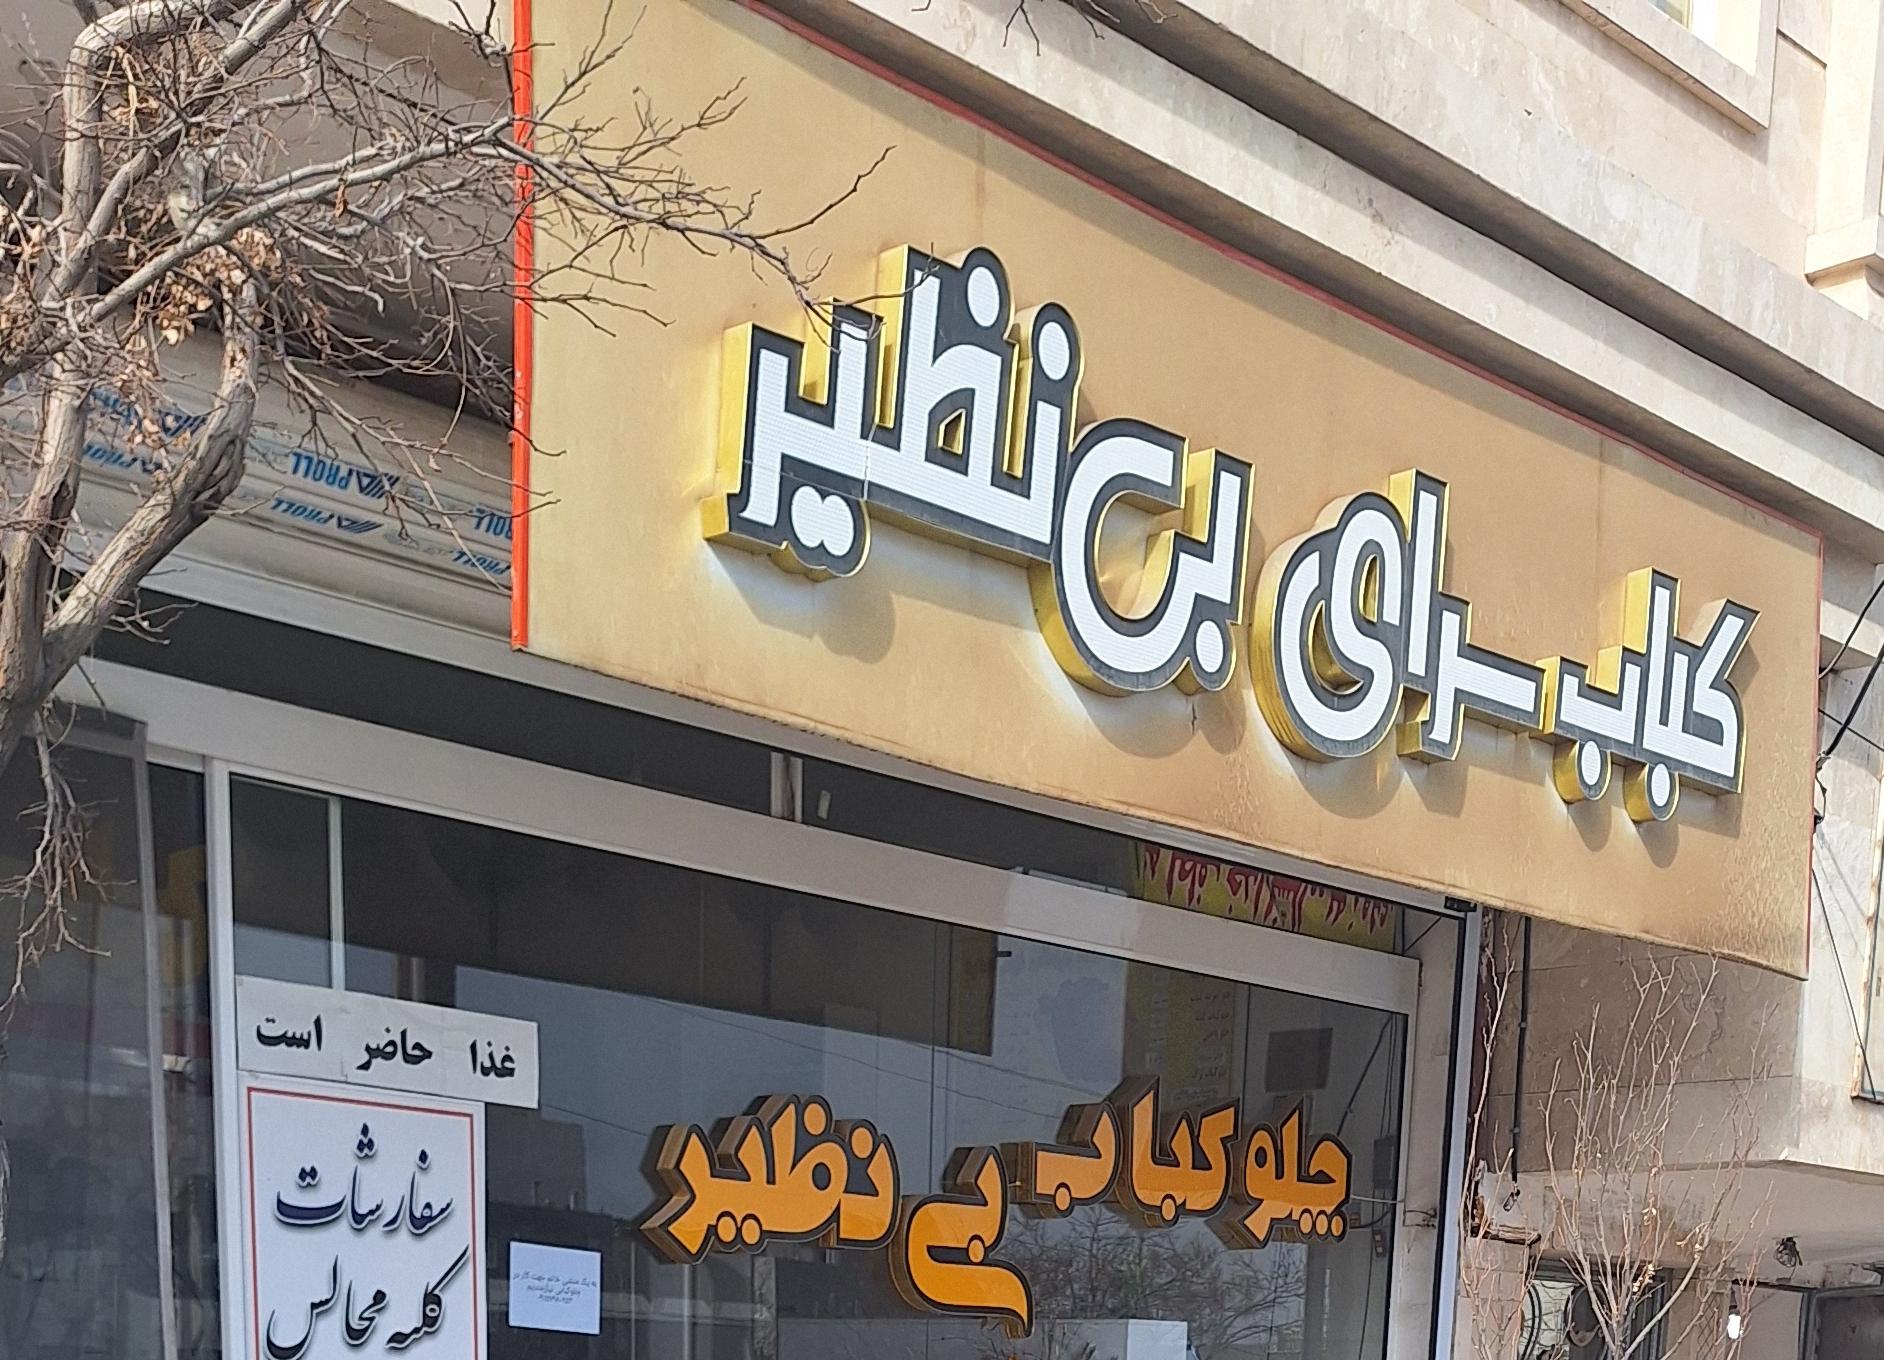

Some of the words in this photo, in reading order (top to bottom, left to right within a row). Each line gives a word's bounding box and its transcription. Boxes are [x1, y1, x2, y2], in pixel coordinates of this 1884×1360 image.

[733, 255, 1077, 567] نظیر
[1058, 427, 1246, 682] بی
[1276, 480, 1541, 752] سرای
[1558, 576, 1752, 808] کباب
[256, 1014, 323, 1051] است
[355, 1025, 434, 1071] حاضر
[470, 1038, 516, 1078] غذا
[275, 1122, 454, 1234] سفارشات
[662, 1097, 899, 1260] نظیر
[904, 1149, 1033, 1334] بی
[1242, 1106, 1352, 1246] چلو
